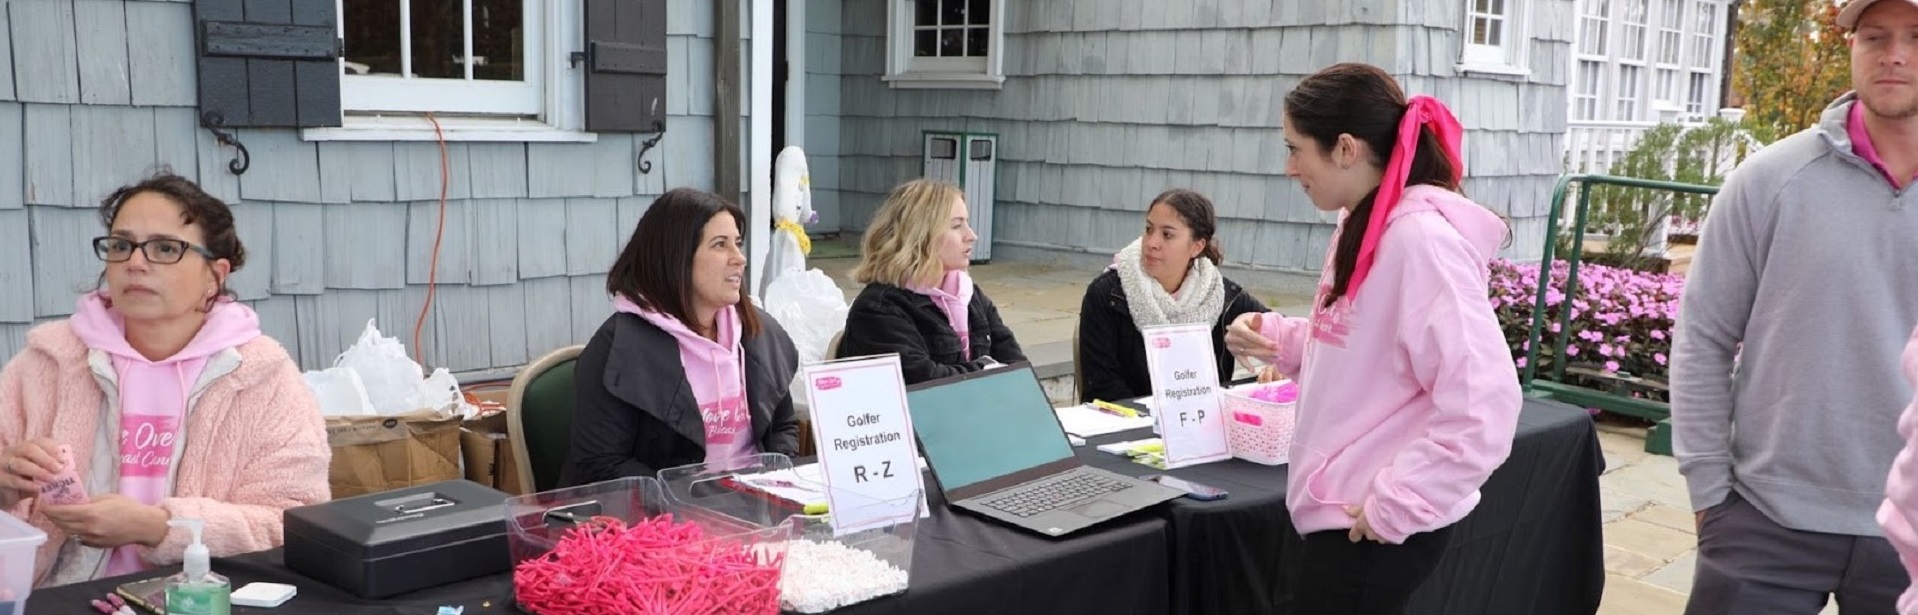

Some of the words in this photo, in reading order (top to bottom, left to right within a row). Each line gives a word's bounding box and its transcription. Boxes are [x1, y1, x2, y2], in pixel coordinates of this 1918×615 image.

[1174, 370, 1197, 381] Golfer
[1165, 386, 1211, 400] Registration
[847, 413, 881, 428] Golfer
[1179, 412, 1187, 427] F
[1197, 409, 1206, 424] P
[136, 422, 174, 450] Ove
[834, 430, 901, 451] Registration
[854, 465, 868, 483] R
[882, 460, 894, 479] Z
